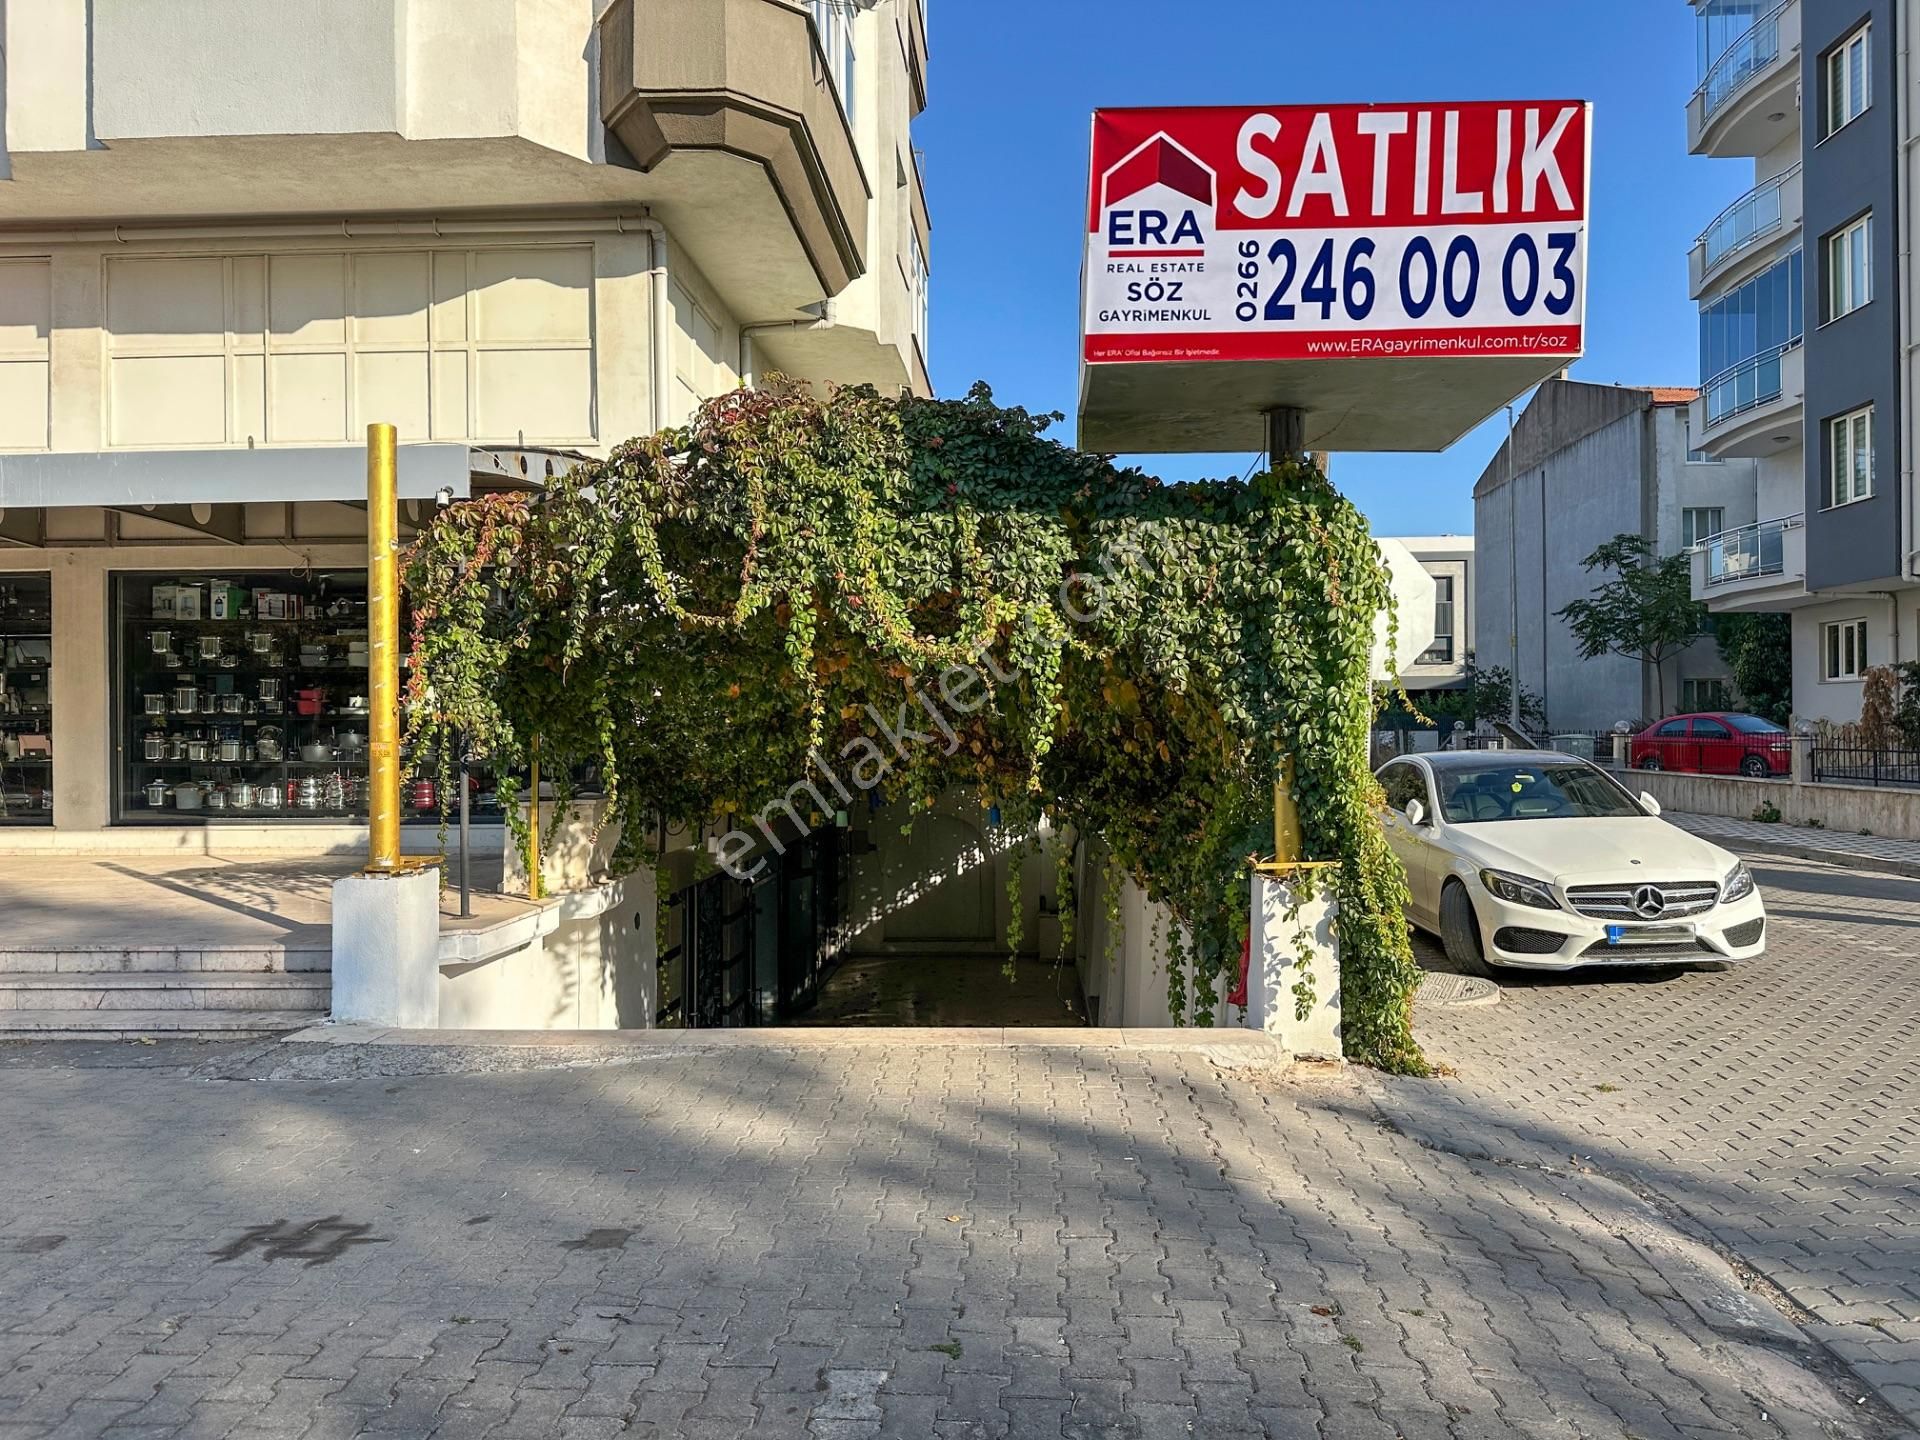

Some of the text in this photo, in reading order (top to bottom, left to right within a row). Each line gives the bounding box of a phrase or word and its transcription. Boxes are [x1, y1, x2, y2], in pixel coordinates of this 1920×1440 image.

[1233, 107, 1578, 219] SATILIK
[1109, 210, 1205, 245] ERA
[1107, 262, 1205, 273] REAL ESTATE
[1235, 239, 1260, 322] 0266
[1263, 232, 1577, 321] 246 00 03
[1127, 277, 1183, 302] SÖZ
[1307, 332, 1568, 353] www.ERAgayrimenkul.com.tr/soz
